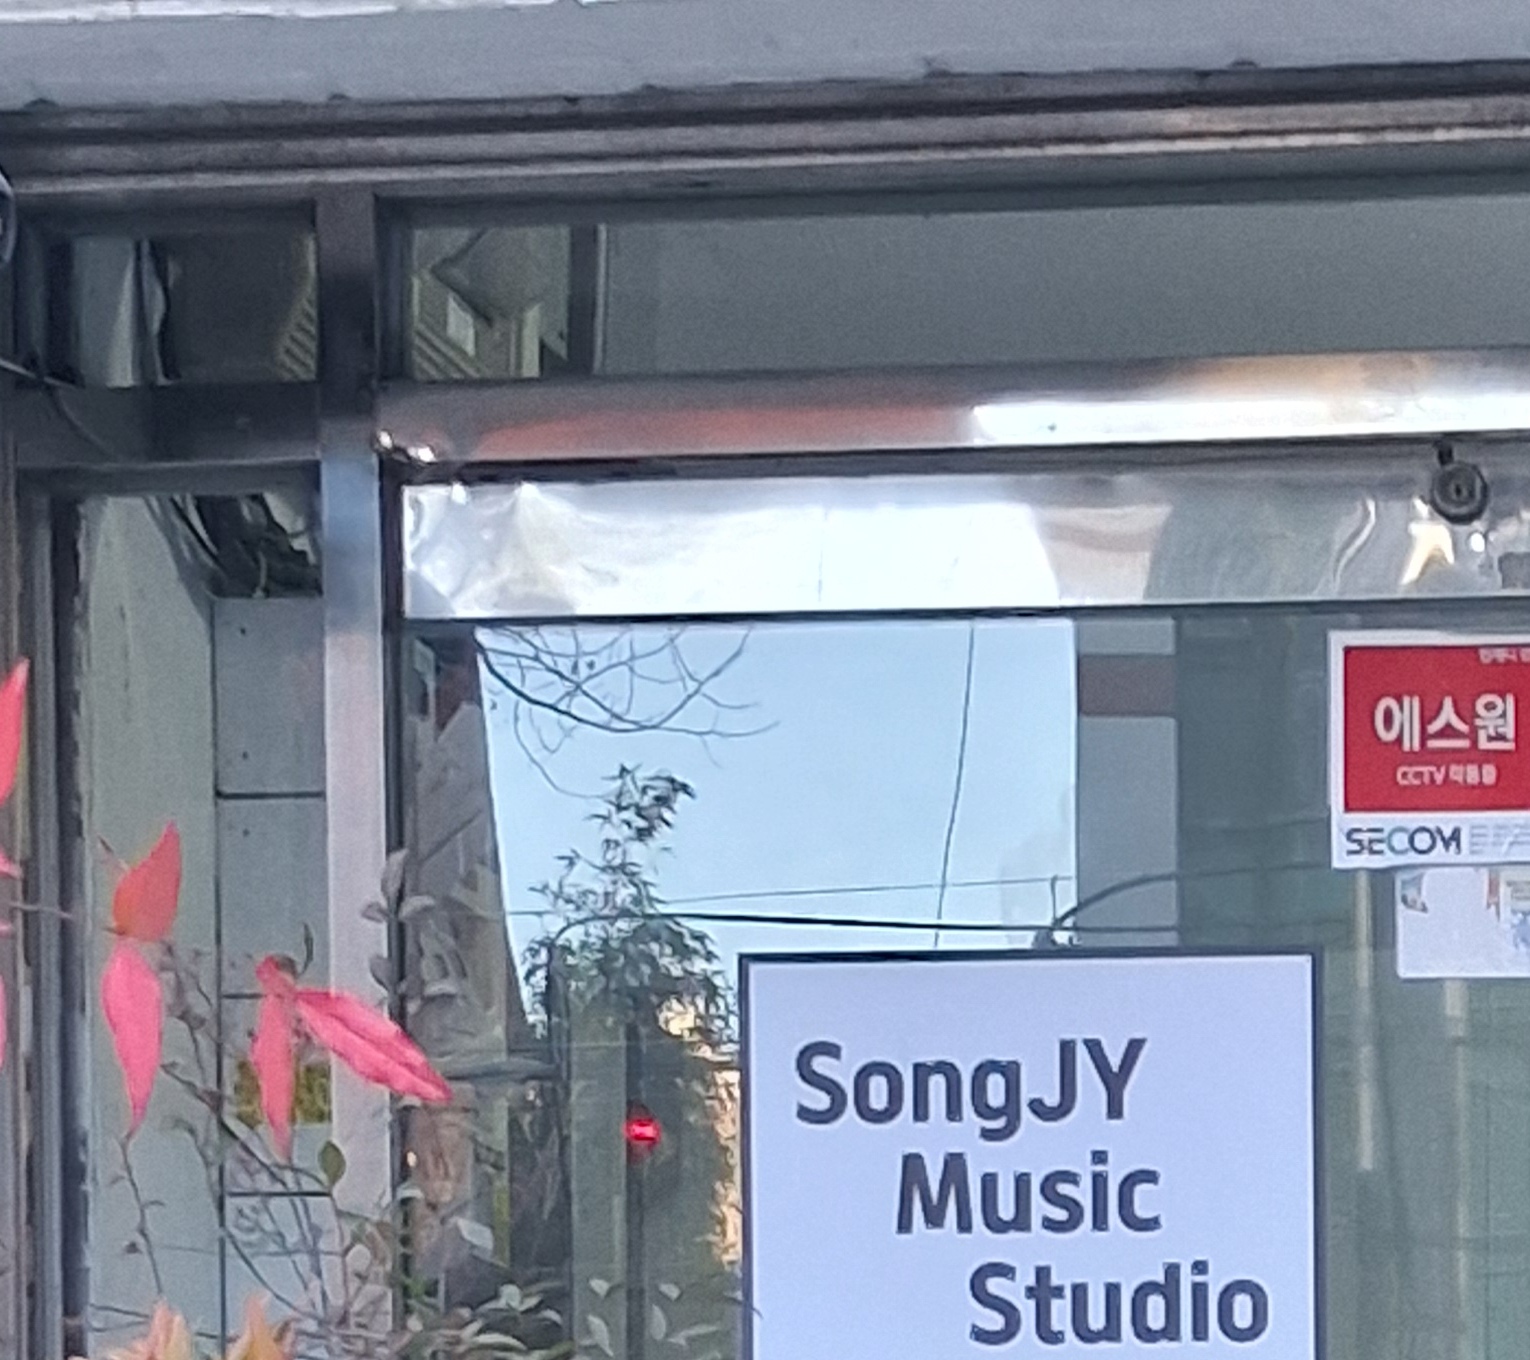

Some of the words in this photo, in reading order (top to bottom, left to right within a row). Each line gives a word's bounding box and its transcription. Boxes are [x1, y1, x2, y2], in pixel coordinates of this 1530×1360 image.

[1373, 692, 1517, 752] 에스원
[1396, 764, 1446, 786] CCTV
[1345, 826, 1463, 857] SECOM
[795, 1037, 1147, 1142] SongJY
[896, 1149, 1162, 1235] Music
[969, 1259, 1269, 1346] Studio
